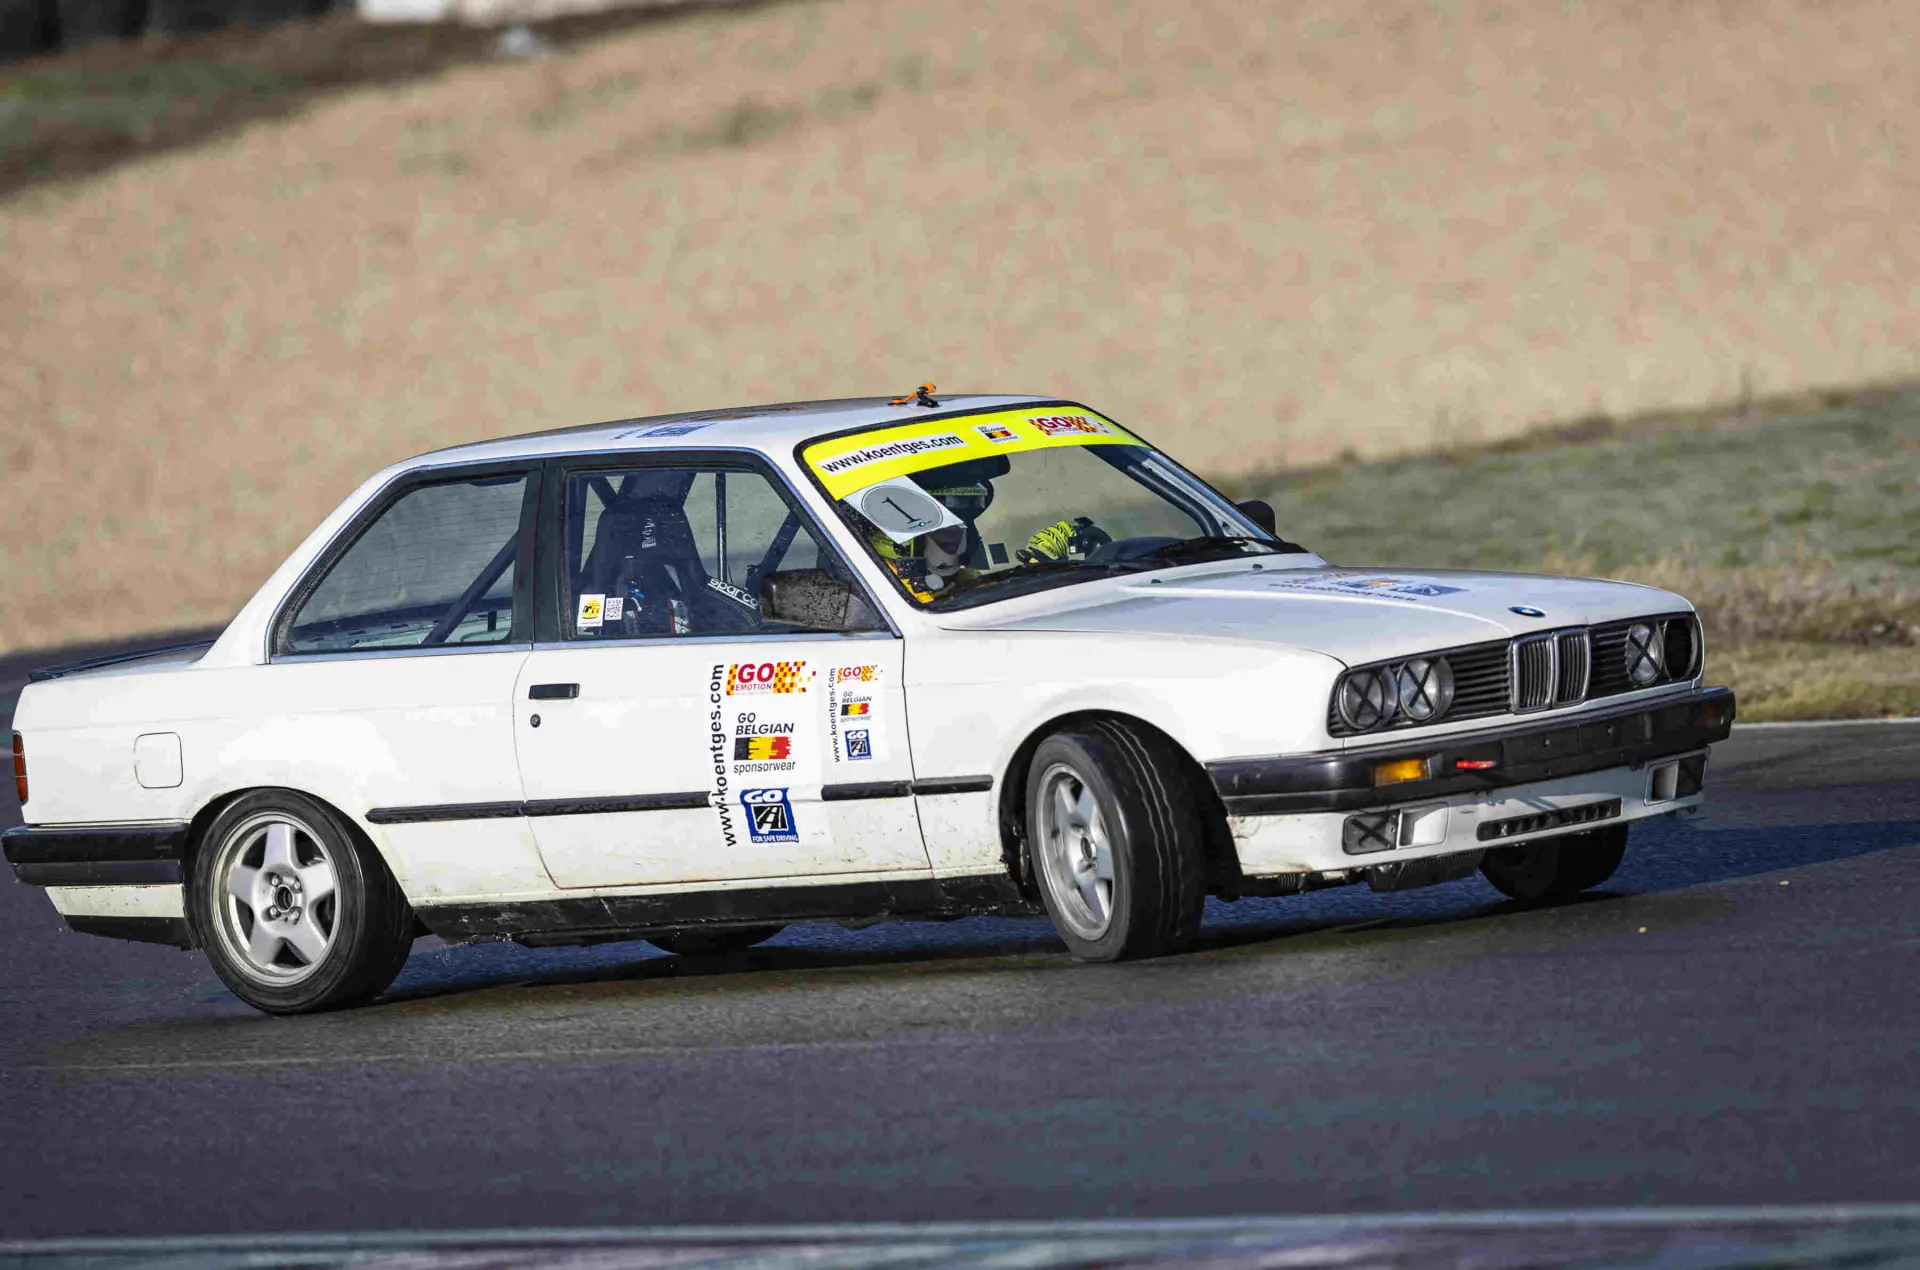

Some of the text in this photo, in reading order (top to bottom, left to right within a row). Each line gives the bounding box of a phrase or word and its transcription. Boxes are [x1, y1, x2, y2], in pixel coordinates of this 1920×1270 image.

[1036, 416, 1073, 429] GO
[822, 435, 964, 473] www.koentges.com
[881, 497, 922, 524] 1
[709, 578, 758, 607] sparco
[738, 663, 775, 683] GO
[843, 666, 862, 677] GO
[735, 683, 772, 691] EMOTION
[738, 712, 756, 723] GO
[828, 667, 840, 763] www.koentges.com
[735, 723, 795, 735] BELGIAN
[846, 730, 868, 740] GO
[709, 664, 737, 847] www.koentges.com
[733, 761, 796, 775] sponsorwear
[743, 789, 784, 803] GO
